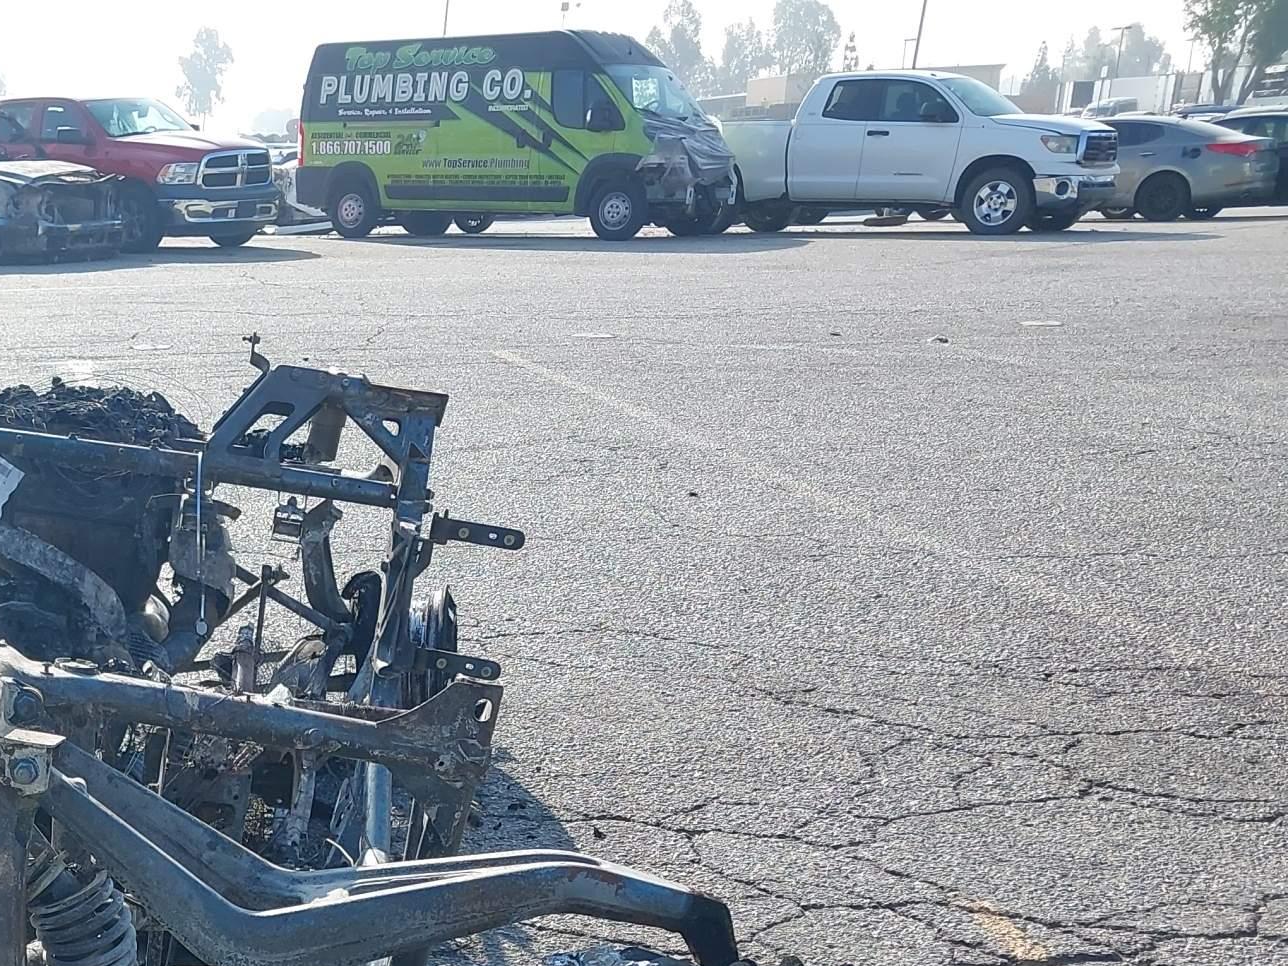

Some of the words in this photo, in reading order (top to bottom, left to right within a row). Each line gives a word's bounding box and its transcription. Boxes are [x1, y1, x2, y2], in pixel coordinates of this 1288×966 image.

[345, 46, 391, 74] Top
[392, 42, 497, 69] Service
[320, 71, 469, 104] PLUMBING
[481, 68, 533, 101] CO.
[394, 107, 432, 116] Installation
[311, 140, 391, 155] 1.866.707.1500
